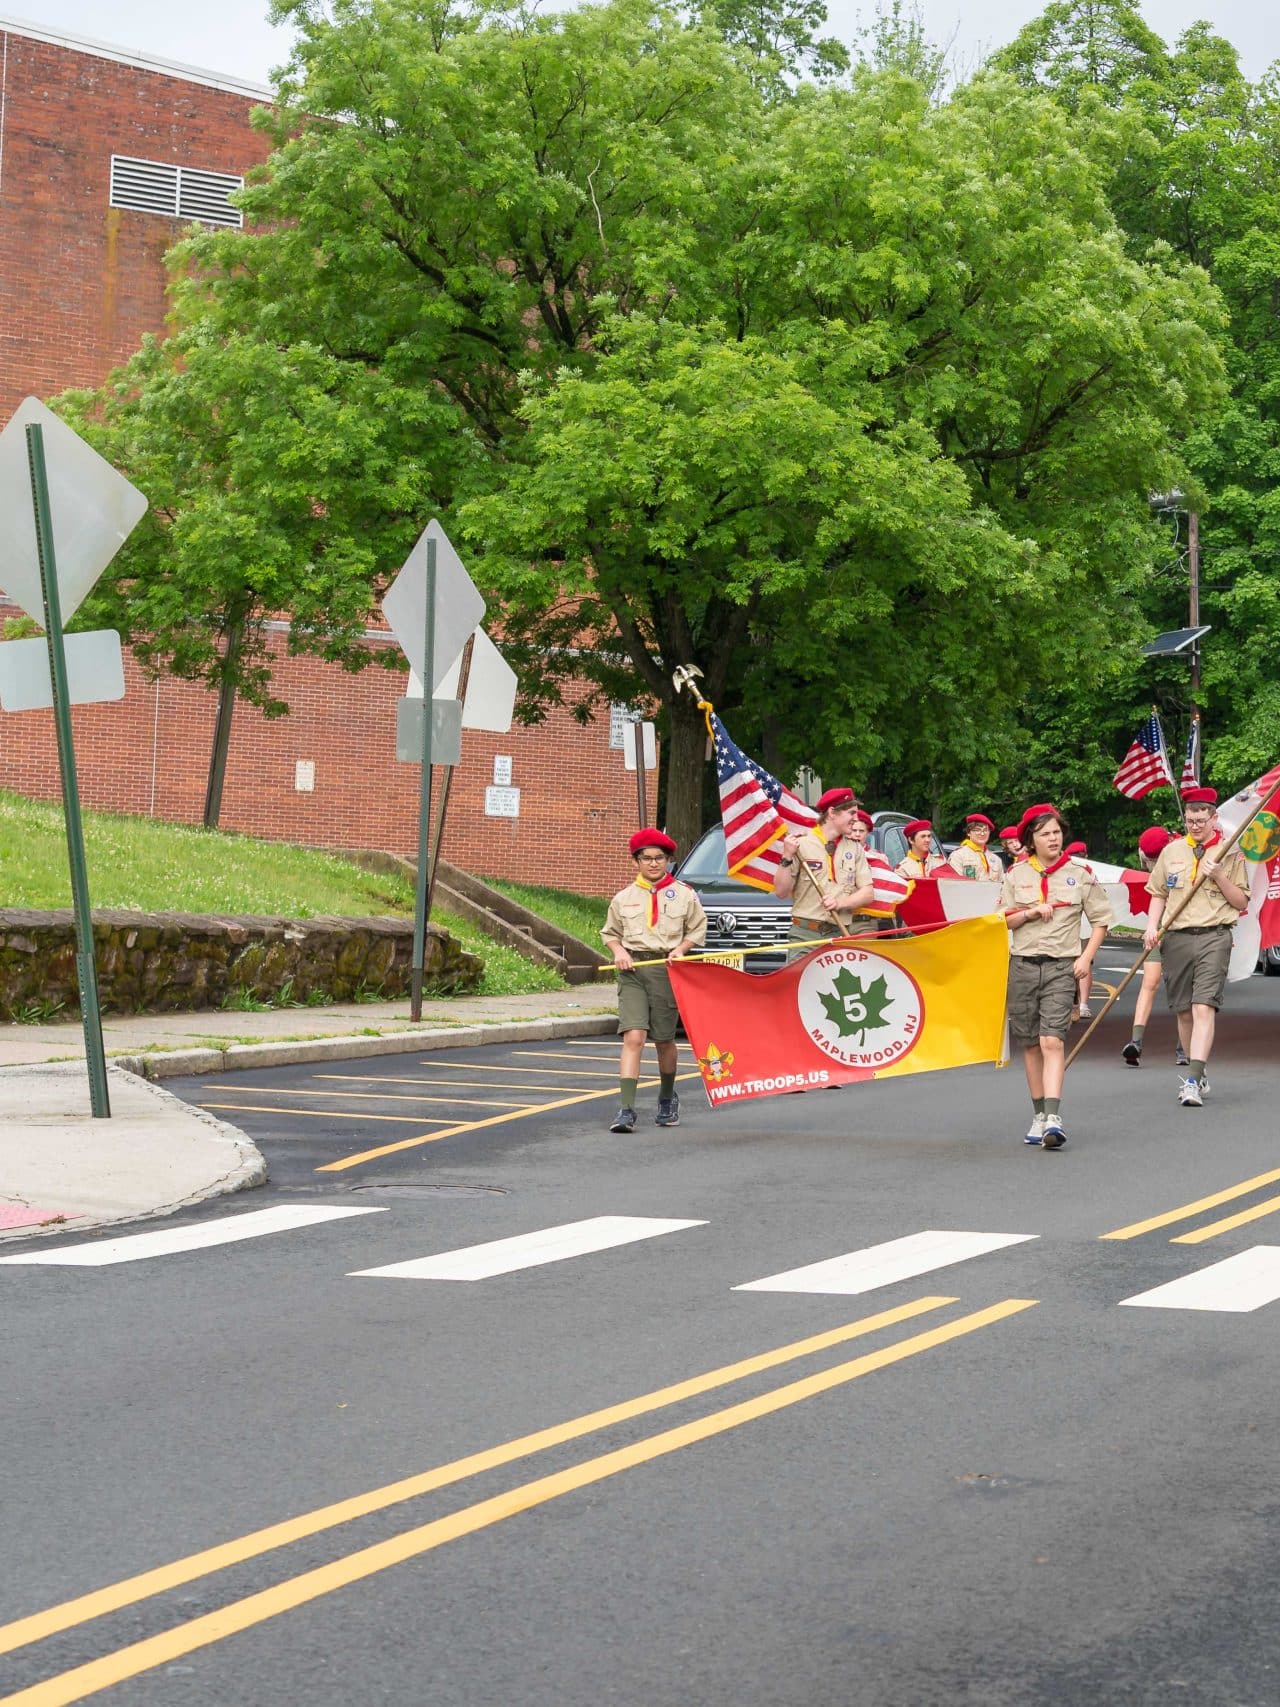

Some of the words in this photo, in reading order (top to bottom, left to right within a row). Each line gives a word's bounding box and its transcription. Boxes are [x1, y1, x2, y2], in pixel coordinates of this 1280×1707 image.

[816, 952, 869, 969] TROOP
[843, 992, 868, 1022] 5
[811, 1028, 909, 1064] MAPLEWOOD,
[903, 1014, 918, 1034] NJ
